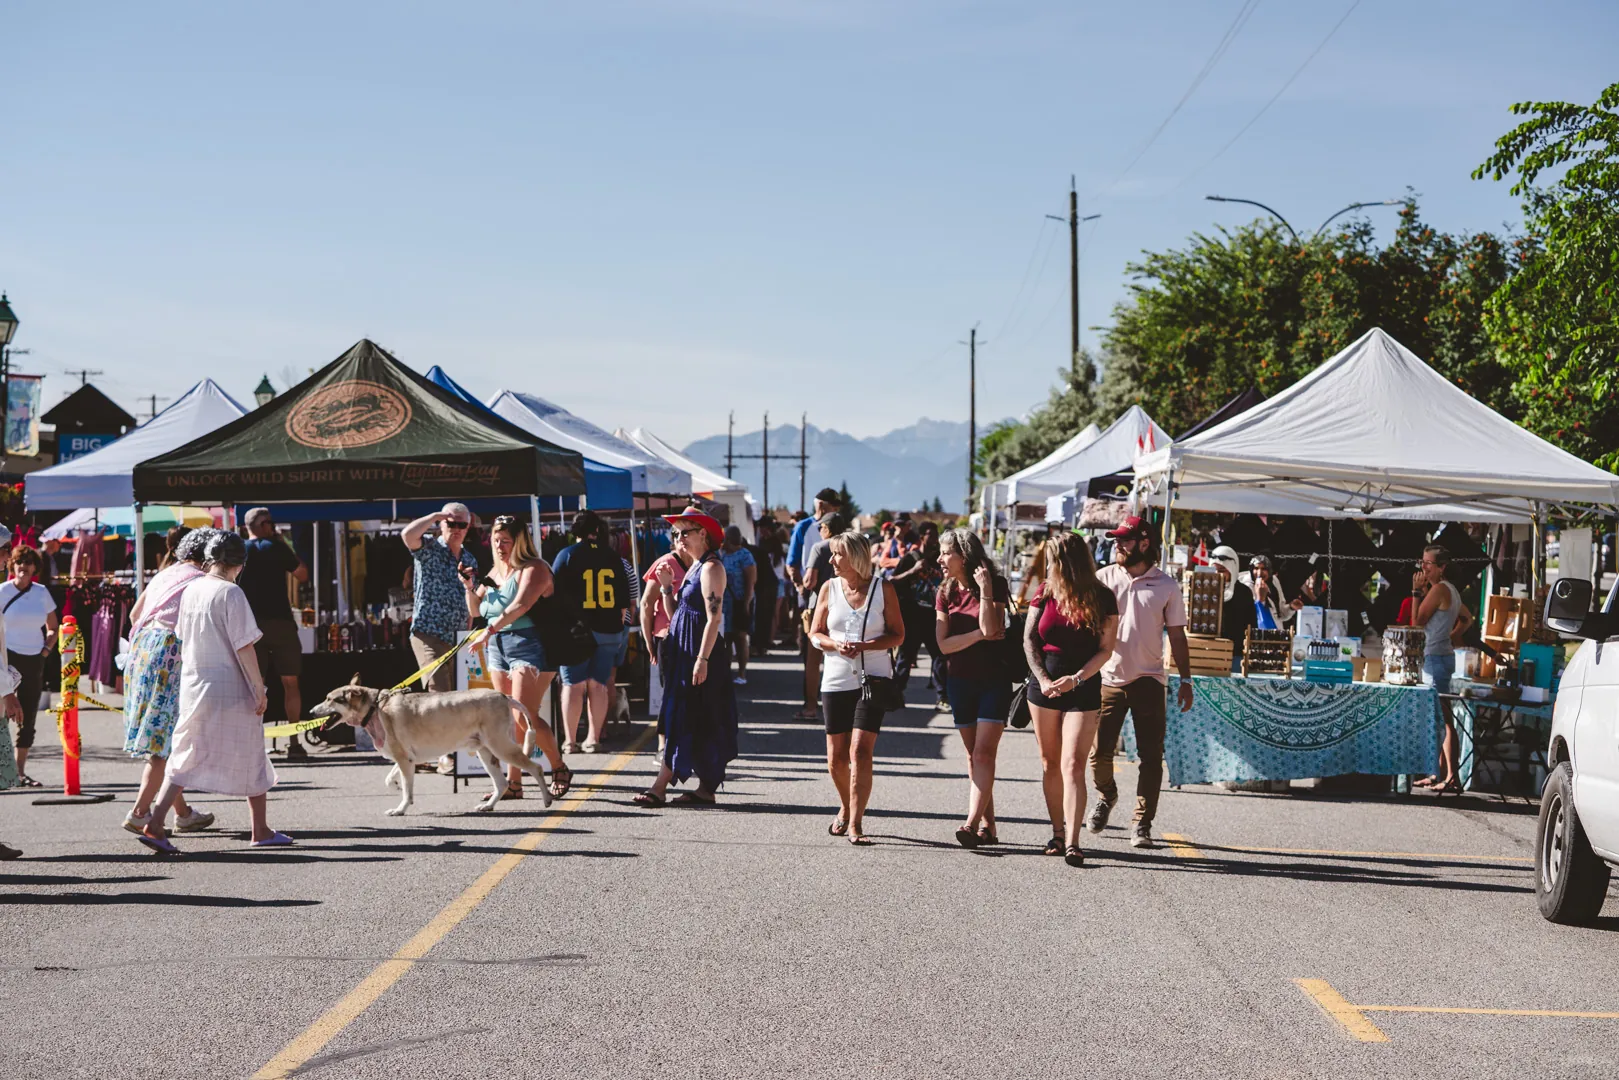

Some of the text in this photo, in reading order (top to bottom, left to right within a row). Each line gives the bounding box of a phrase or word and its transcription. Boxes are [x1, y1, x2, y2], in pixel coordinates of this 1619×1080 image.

[71, 437, 102, 451] BIG
[167, 473, 236, 488] UNLOCK
[240, 471, 284, 485] WILD
[288, 469, 346, 483] SPIRIT
[350, 468, 395, 481] WITH
[582, 568, 615, 609] 16
